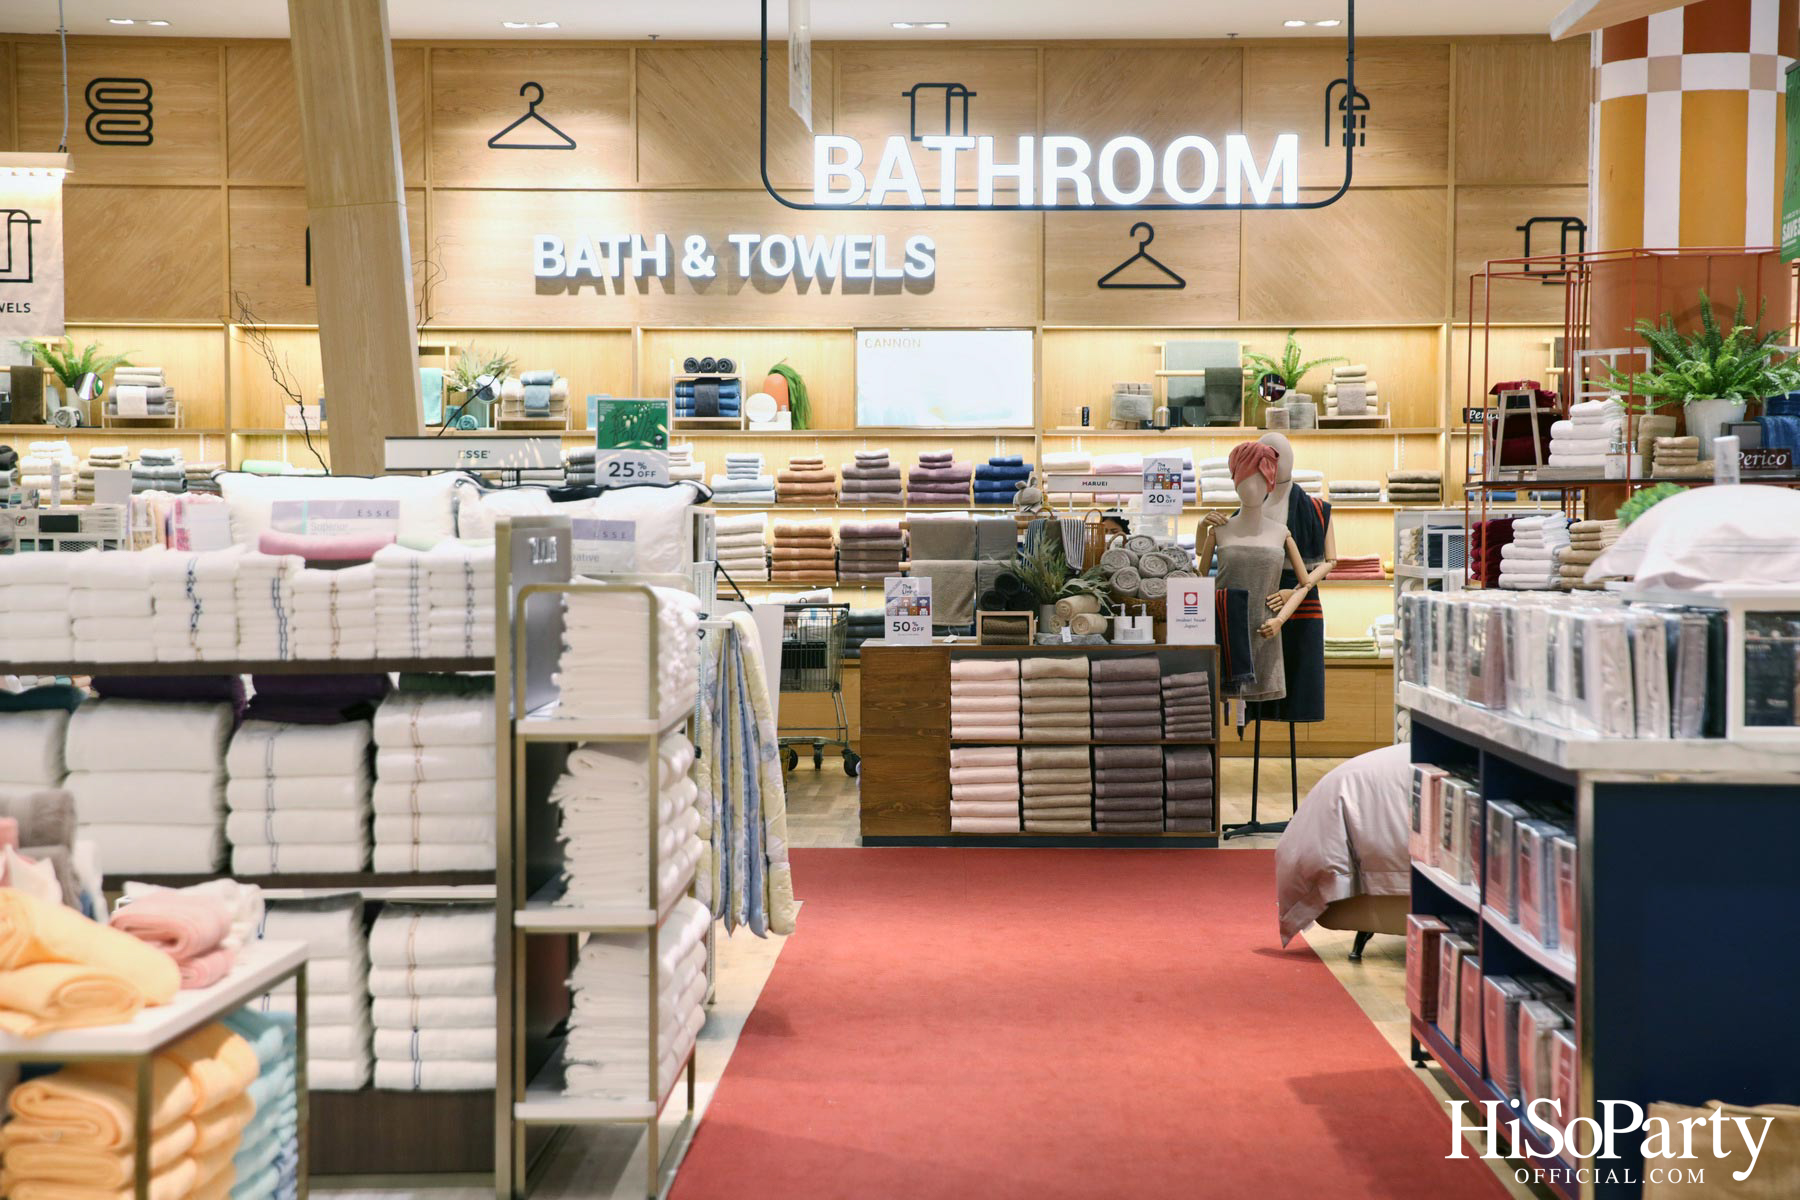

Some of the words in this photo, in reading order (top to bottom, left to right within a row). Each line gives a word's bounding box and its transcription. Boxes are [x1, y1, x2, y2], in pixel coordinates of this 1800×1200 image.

[813, 134, 1299, 206] BATHROOM
[534, 233, 666, 278] BATH
[681, 234, 716, 278] &
[727, 233, 935, 279] TOWELS
[864, 337, 921, 349] CANNON
[1736, 450, 1787, 466] Perico
[609, 462, 634, 477] 25
[1149, 494, 1165, 504] 20
[893, 621, 911, 632] 50
